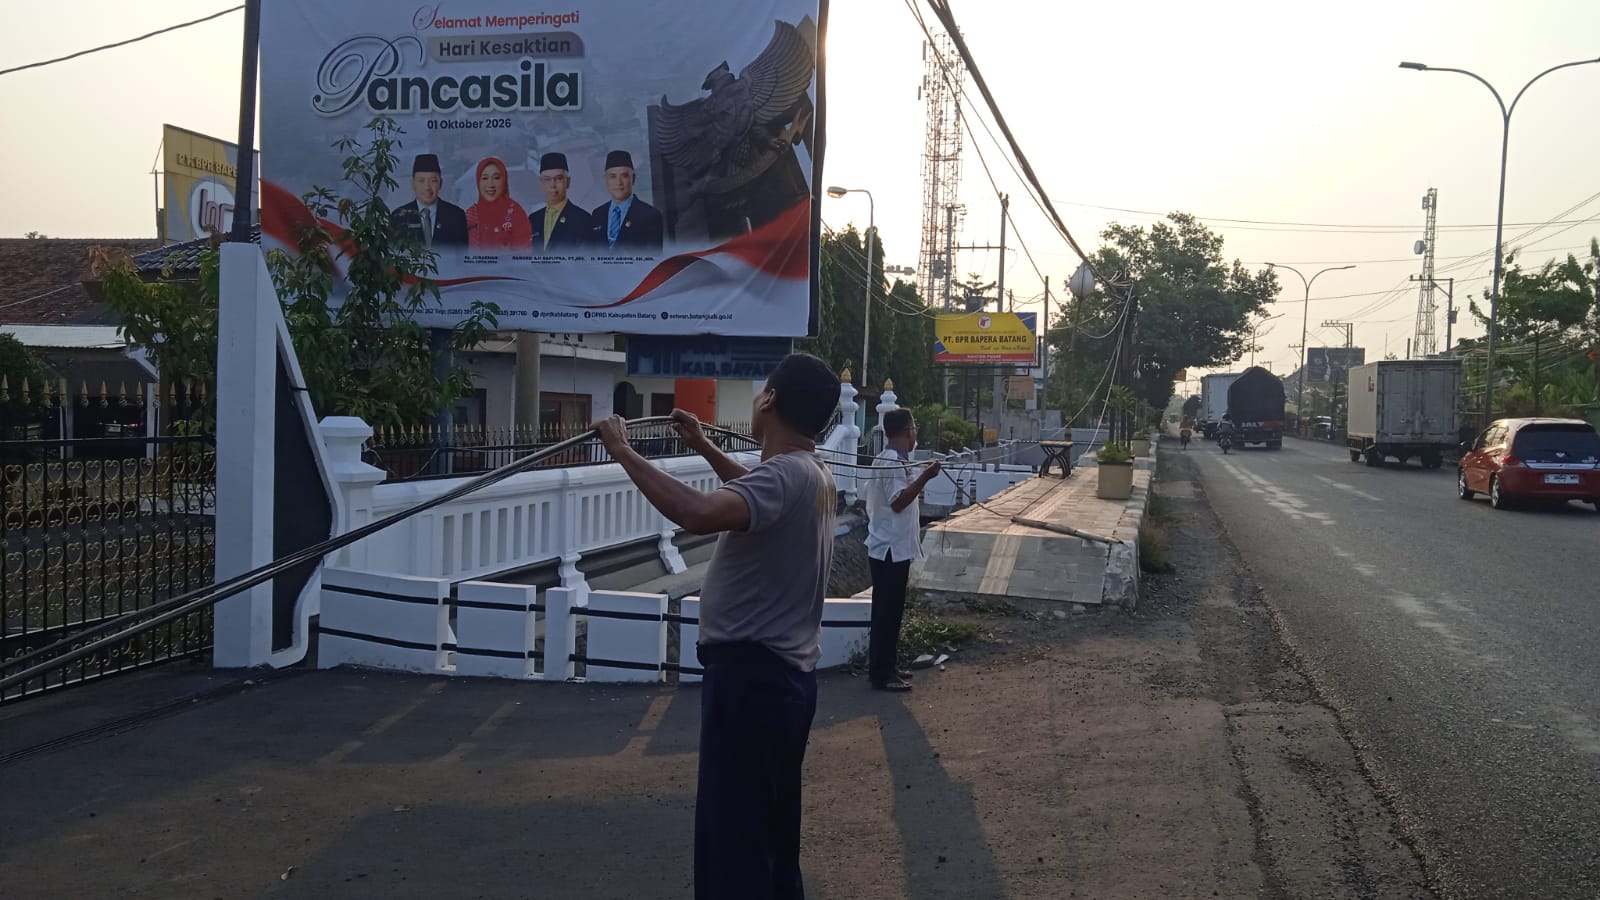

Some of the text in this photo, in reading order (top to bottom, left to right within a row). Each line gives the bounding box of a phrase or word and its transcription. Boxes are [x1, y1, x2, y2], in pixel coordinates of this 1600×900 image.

[412, 2, 580, 31] Selamat Memperingati
[439, 37, 571, 57] Hari Kesaktian
[313, 36, 579, 113] Pancasila
[427, 118, 512, 130] 01 Oktober 2026
[215, 162, 238, 178] BAPE
[638, 312, 657, 320] Batang
[943, 335, 1027, 344] PT. BPR BAPERA BATANG
